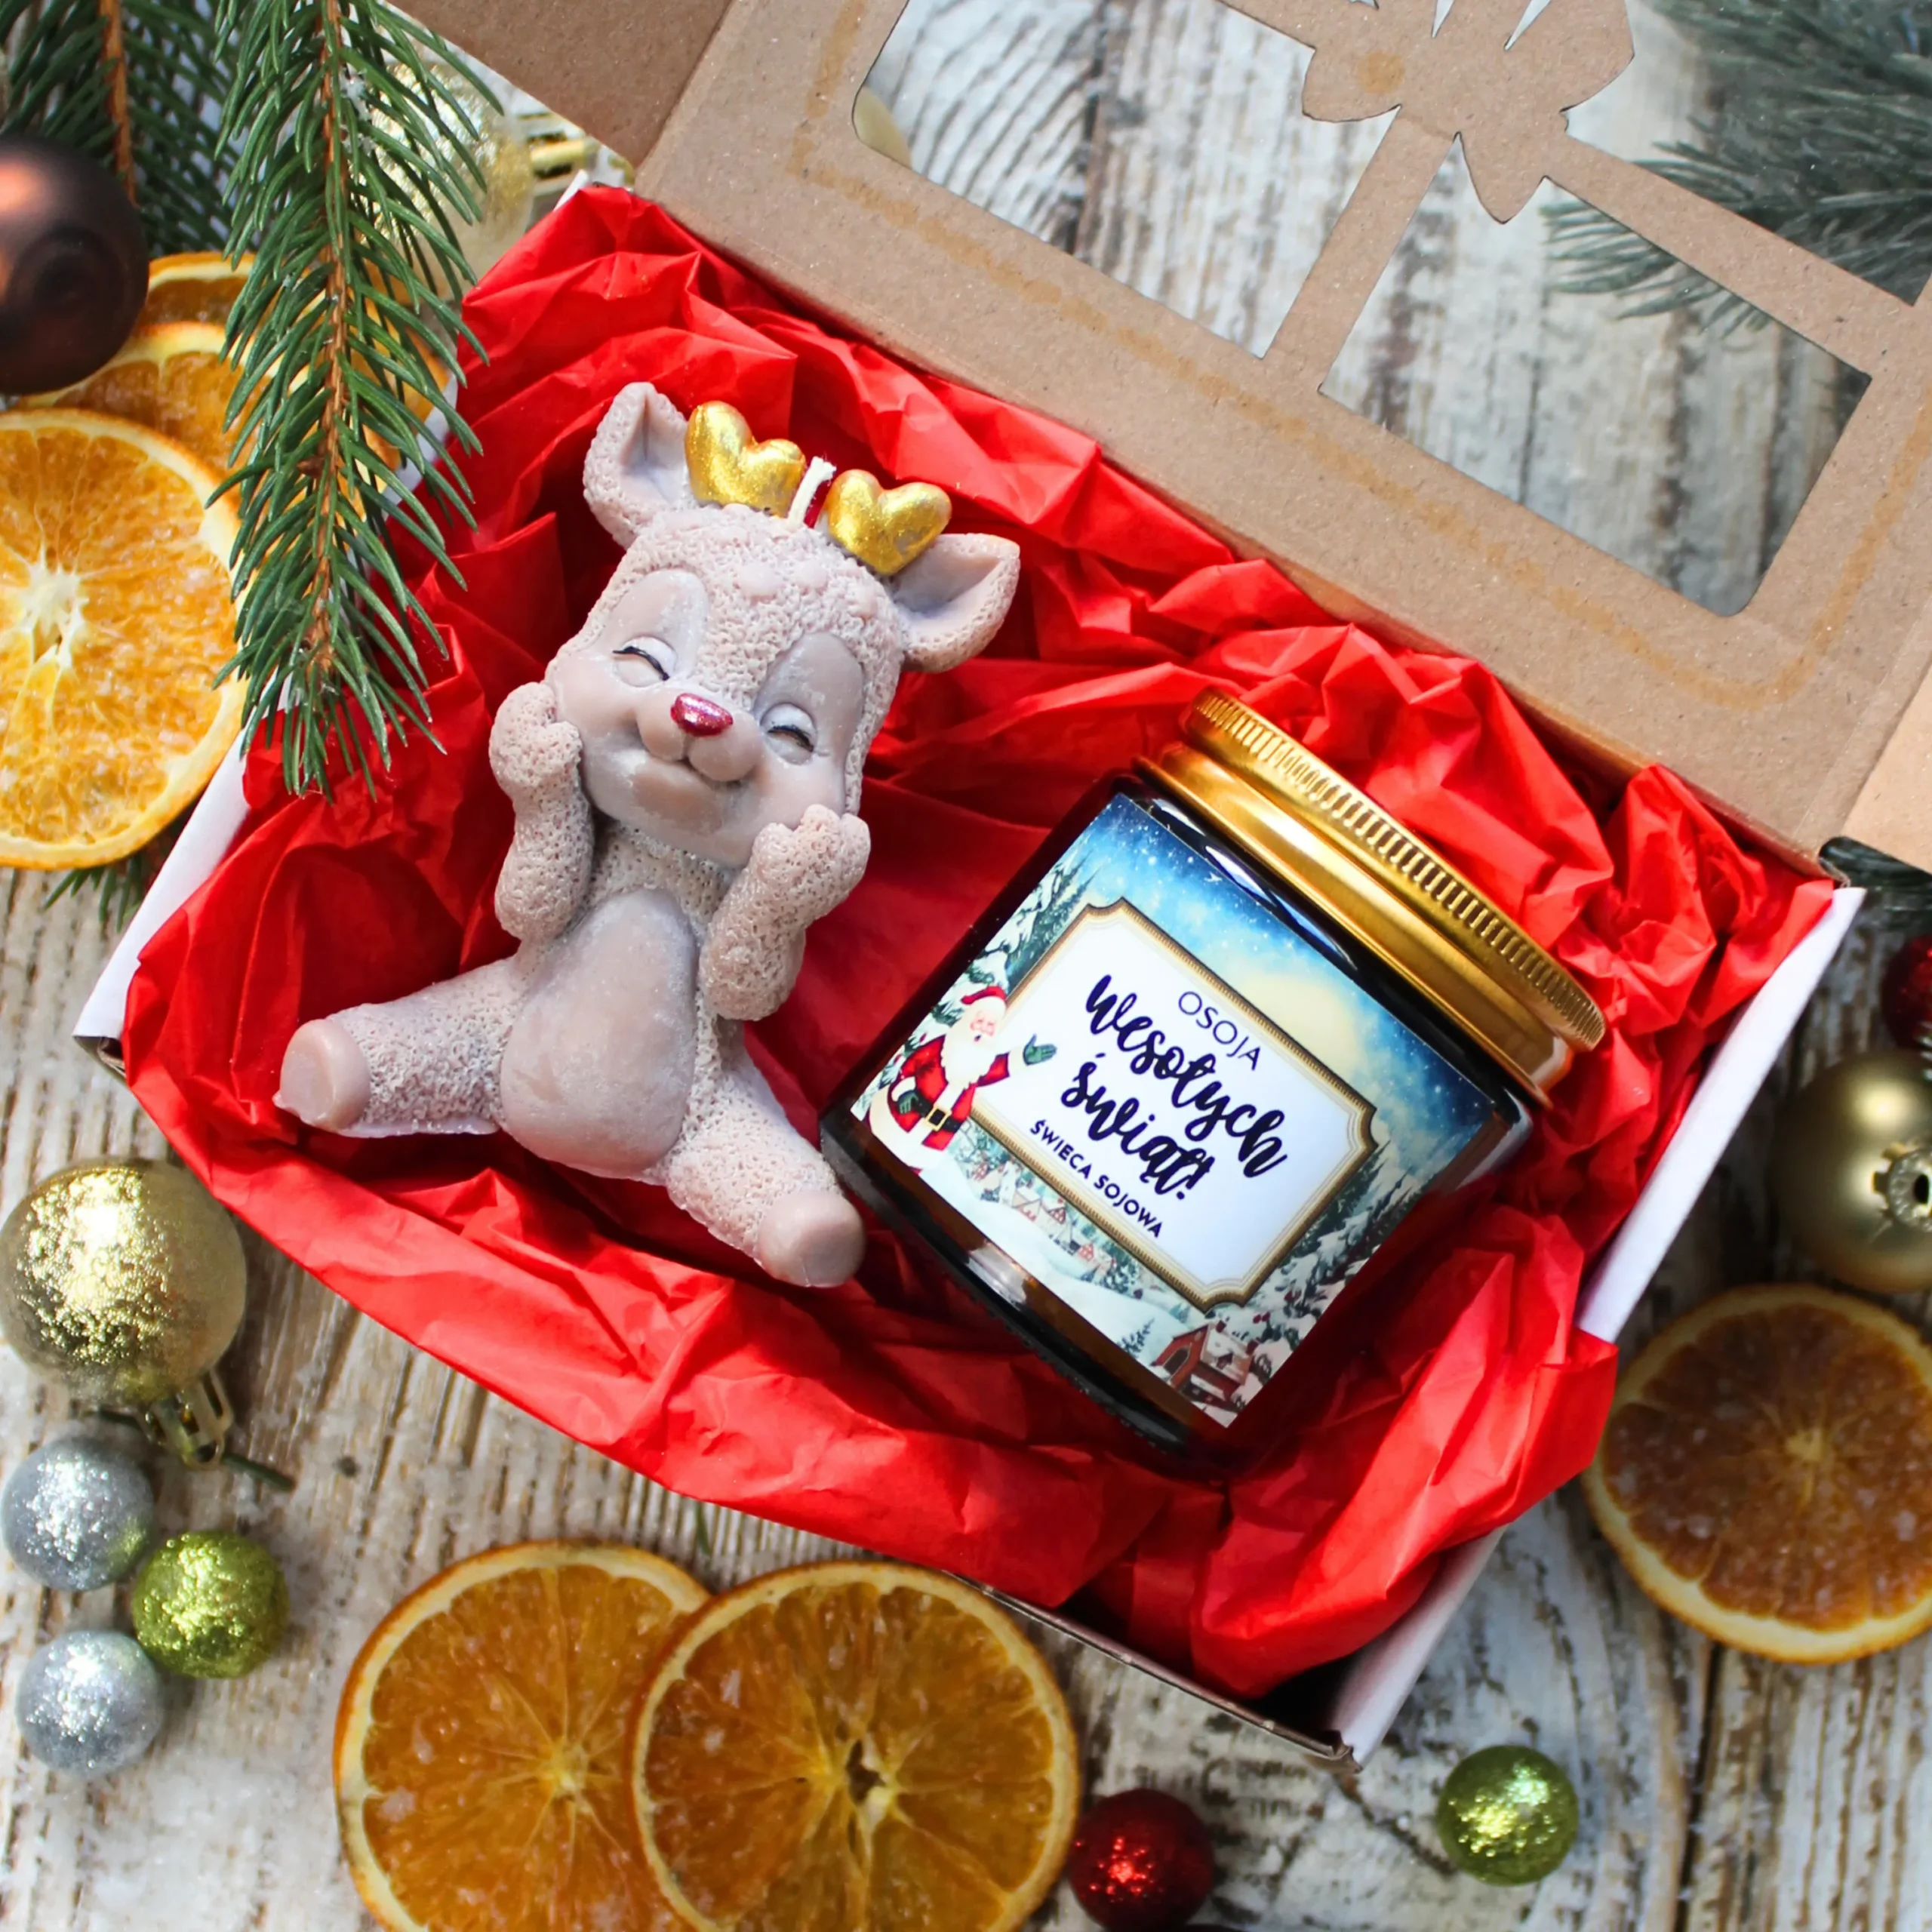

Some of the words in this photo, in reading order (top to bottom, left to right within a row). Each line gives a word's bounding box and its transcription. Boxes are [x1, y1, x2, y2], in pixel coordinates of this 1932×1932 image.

[1177, 991, 1261, 1071] OSOJA
[1030, 1119, 1092, 1180] ŚWIECA
[1094, 1174, 1163, 1238] SOJOWA
